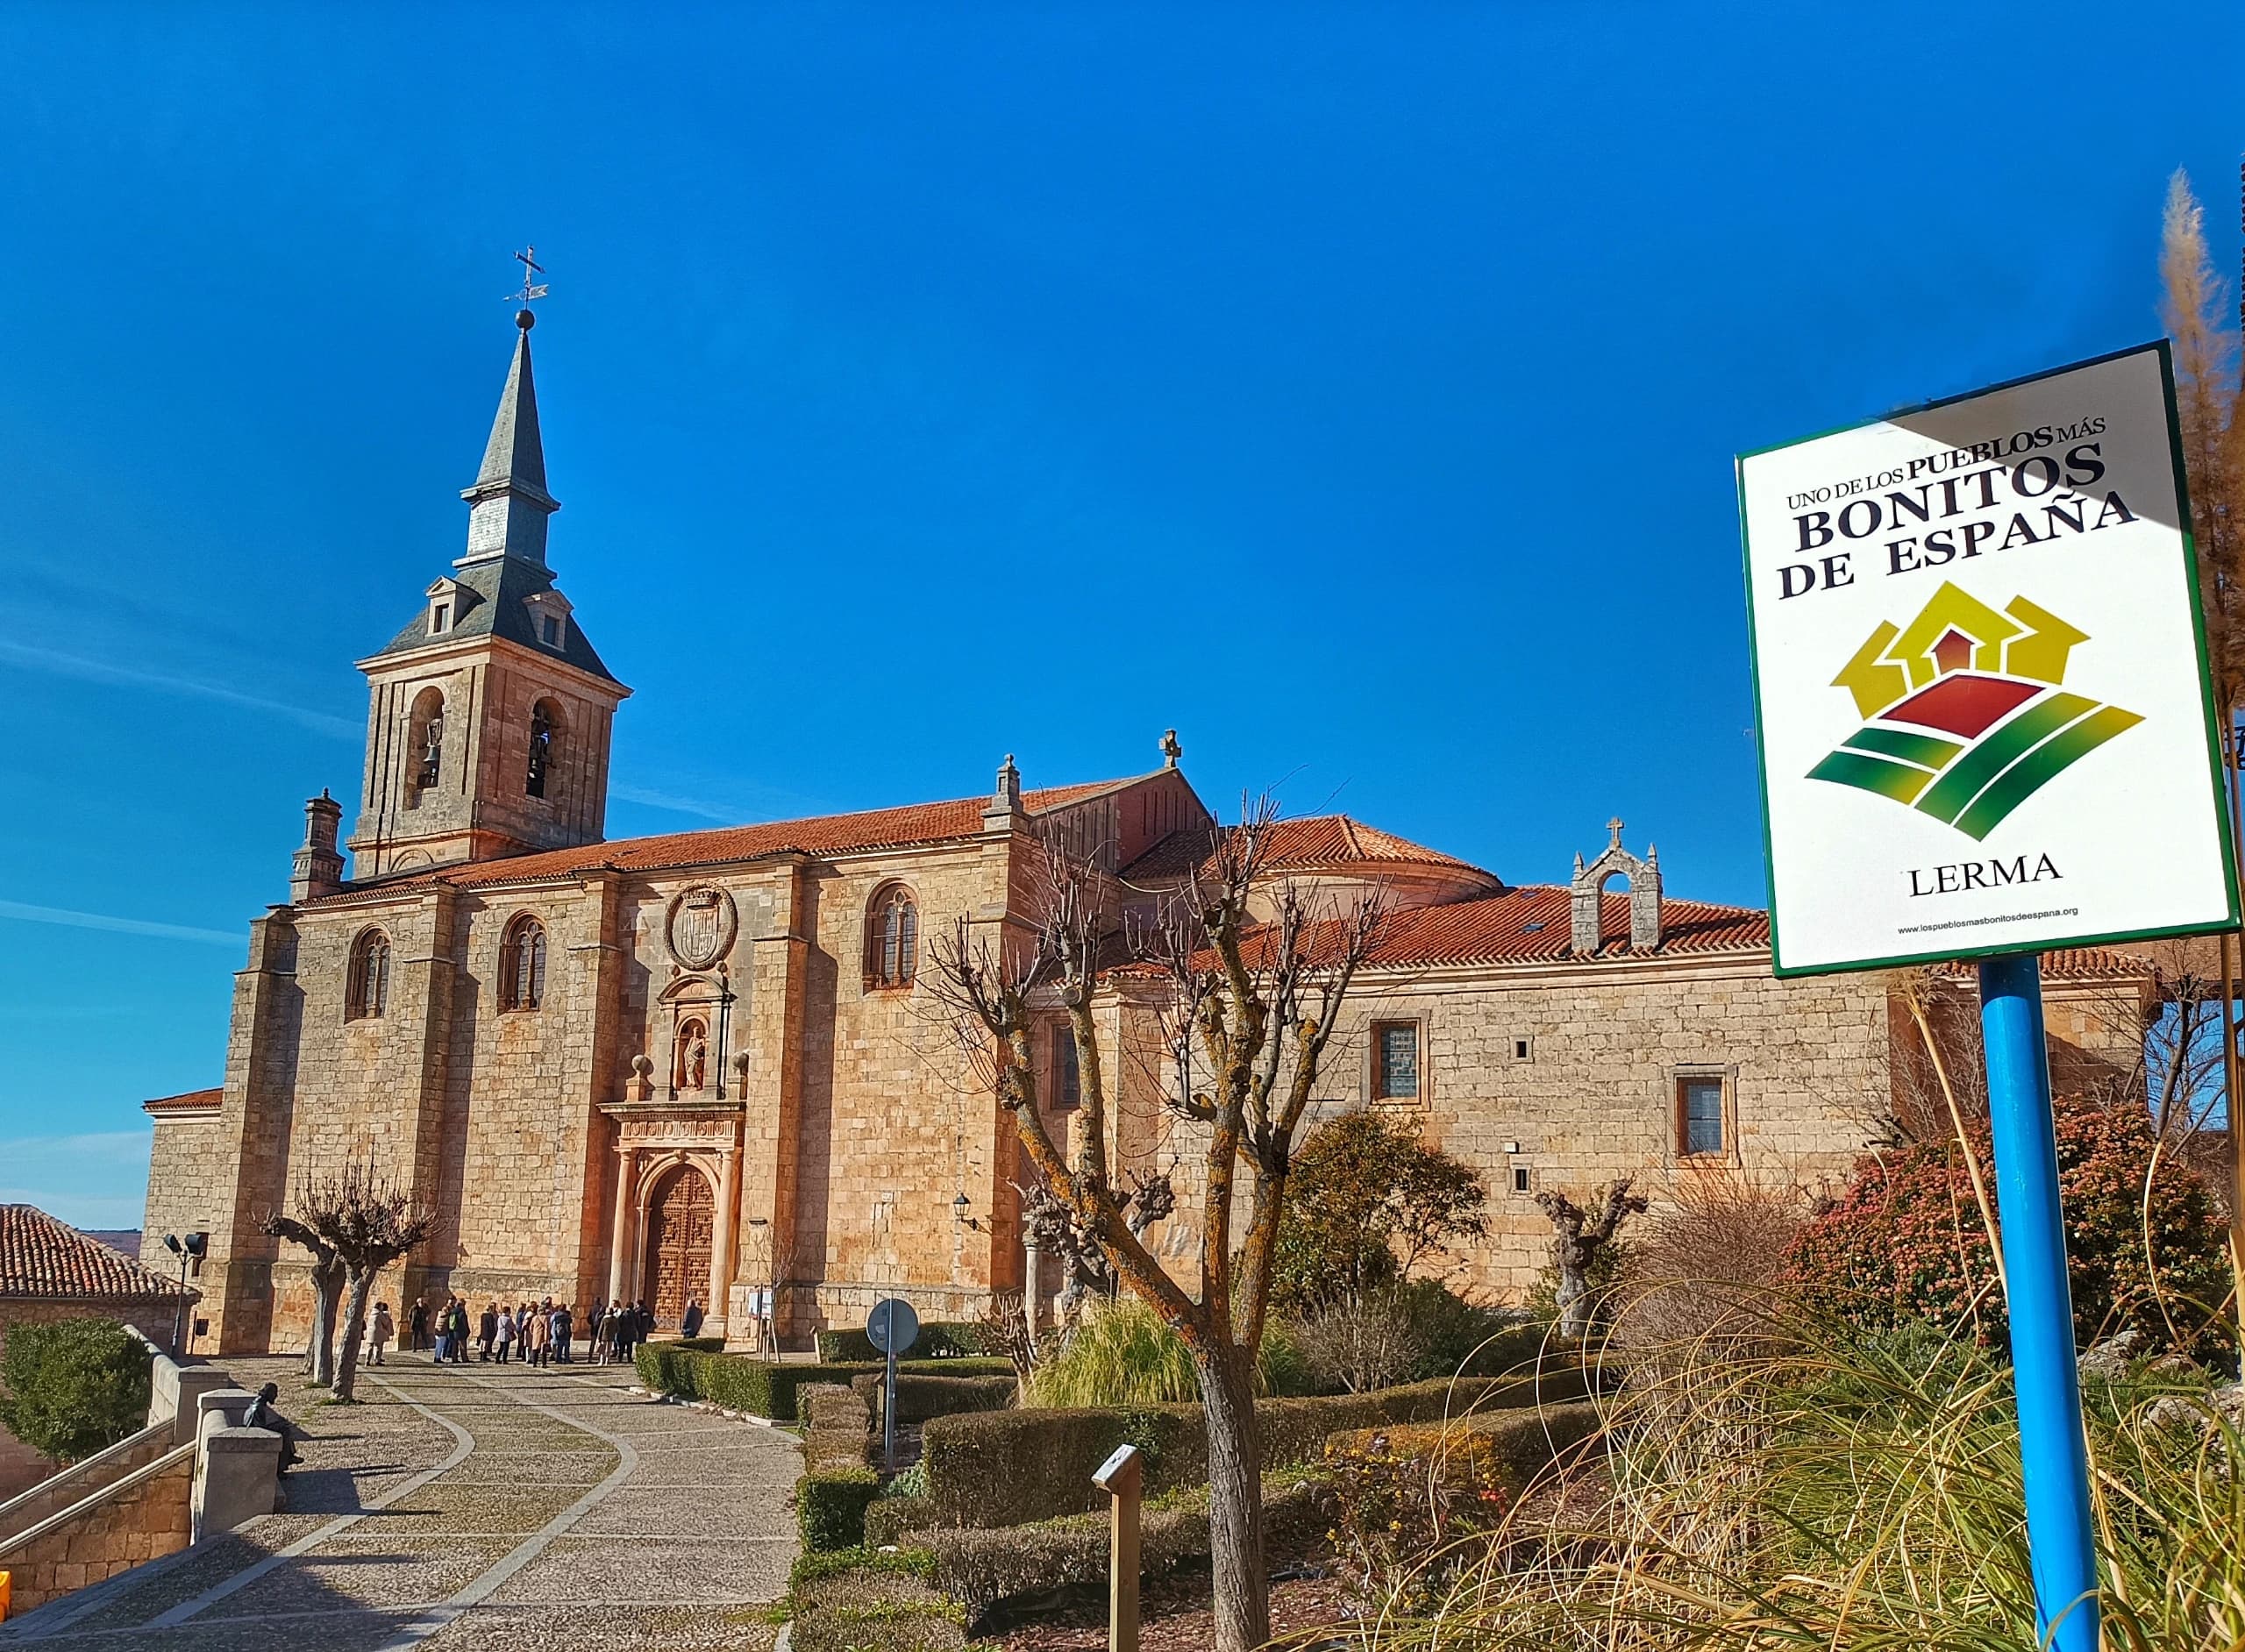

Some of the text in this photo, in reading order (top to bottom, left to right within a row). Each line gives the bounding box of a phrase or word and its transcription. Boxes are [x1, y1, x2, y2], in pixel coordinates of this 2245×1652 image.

[1786, 417, 2106, 509] UNO DE LOS PUEBLOS MÁS
[1792, 442, 2106, 552] BONITOS
[1776, 490, 2140, 600] DE ESPAÑA
[1906, 852, 2063, 897] LERMA
[1898, 907, 2078, 935] www.lospueblosmasbonitosdeespana.org
